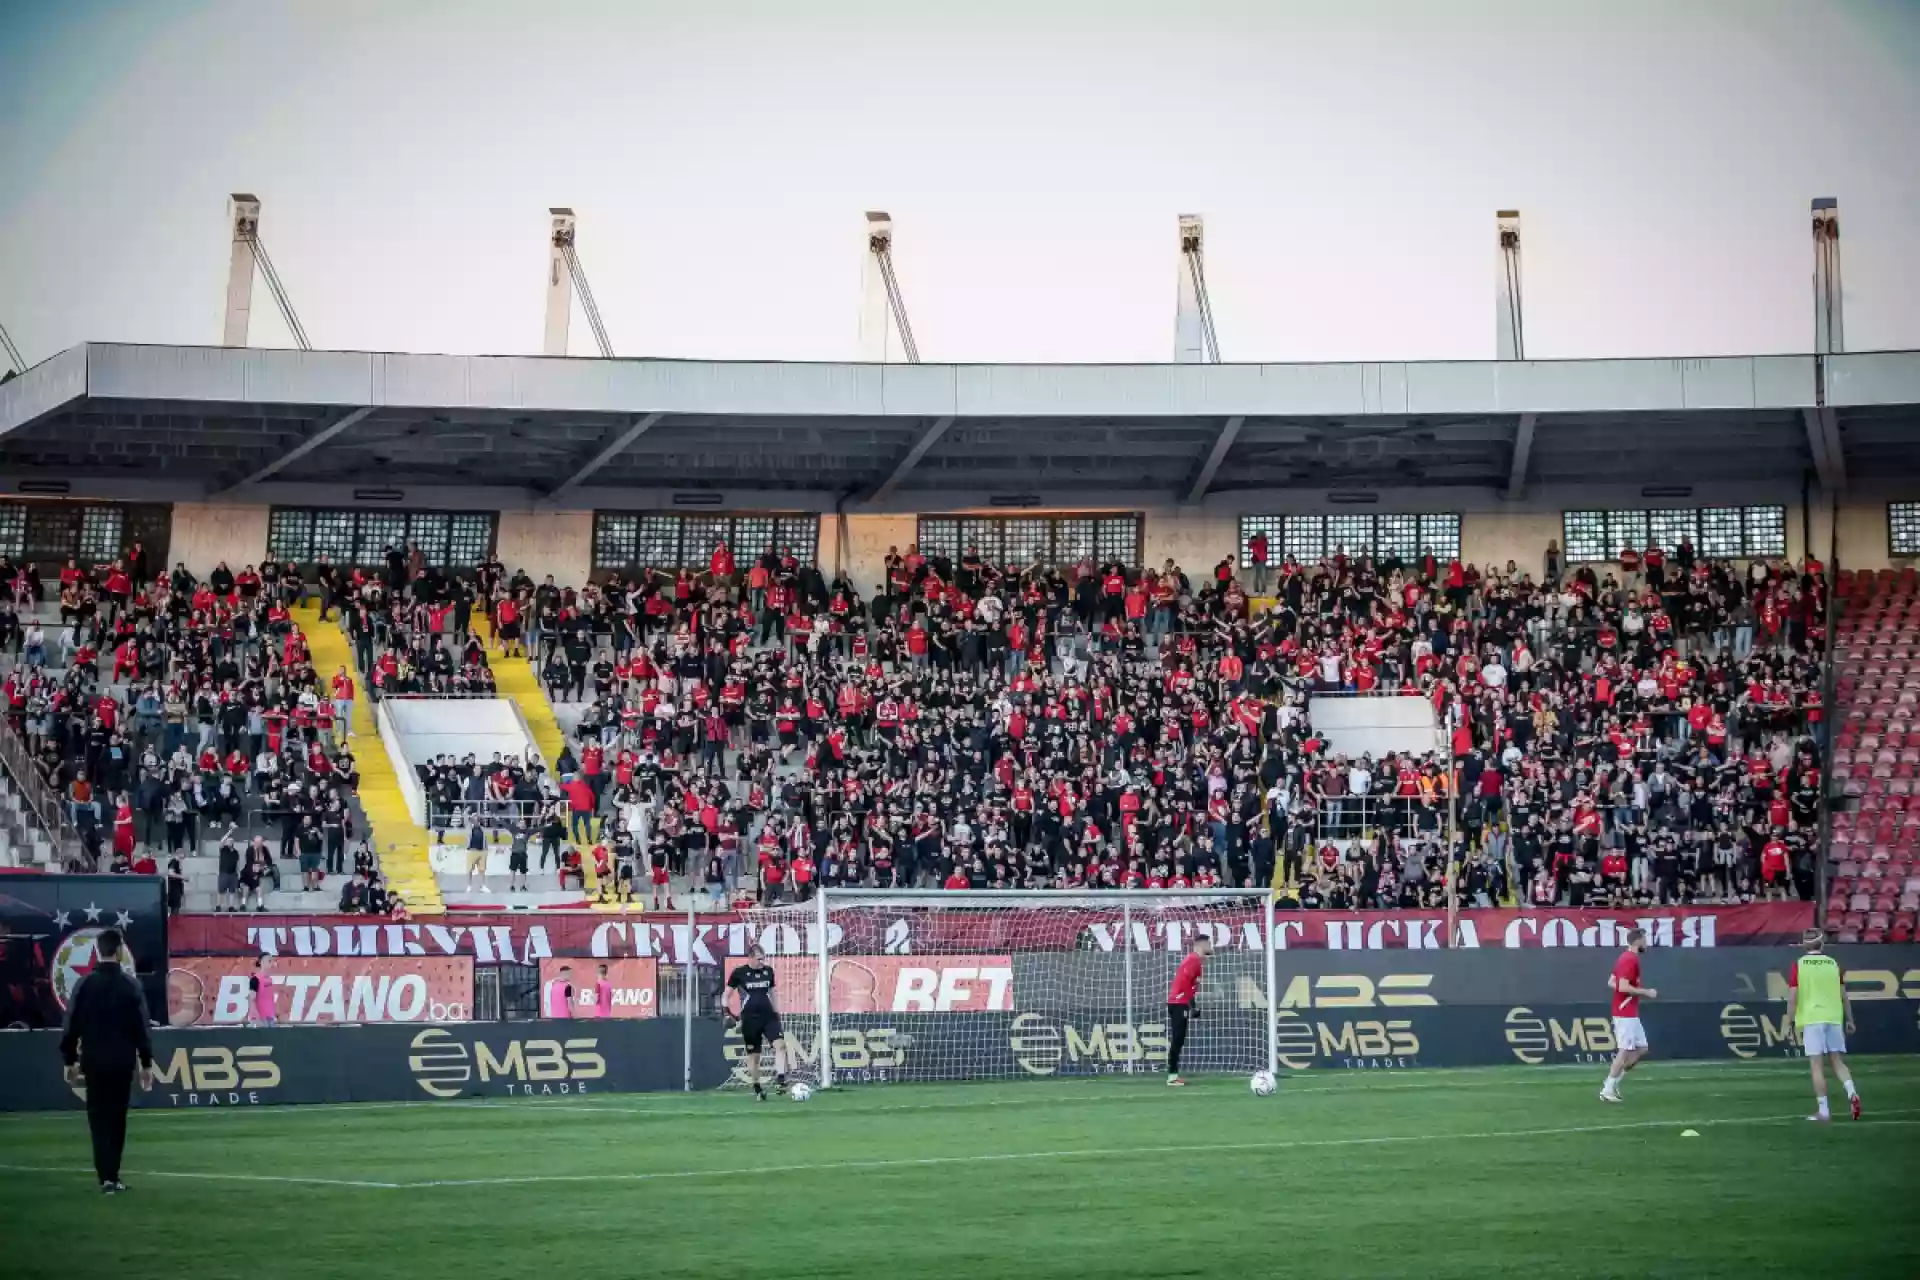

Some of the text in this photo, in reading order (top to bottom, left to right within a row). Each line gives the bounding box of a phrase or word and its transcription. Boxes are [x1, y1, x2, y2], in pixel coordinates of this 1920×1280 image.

[591, 921, 843, 964] СЕКТОР
[1325, 919, 1480, 949] ЦСКА
[783, 1028, 905, 1070] MBS
[1063, 1023, 1171, 1061] MBS
[1316, 1020, 1420, 1057] MBS
[1548, 1017, 1617, 1052] MB
[136, 1046, 281, 1090] MBS
[474, 1038, 606, 1081] MBS
[1344, 1058, 1406, 1068] TRADE
[170, 1091, 260, 1105] TRADE
[506, 1081, 587, 1096] TRADE
